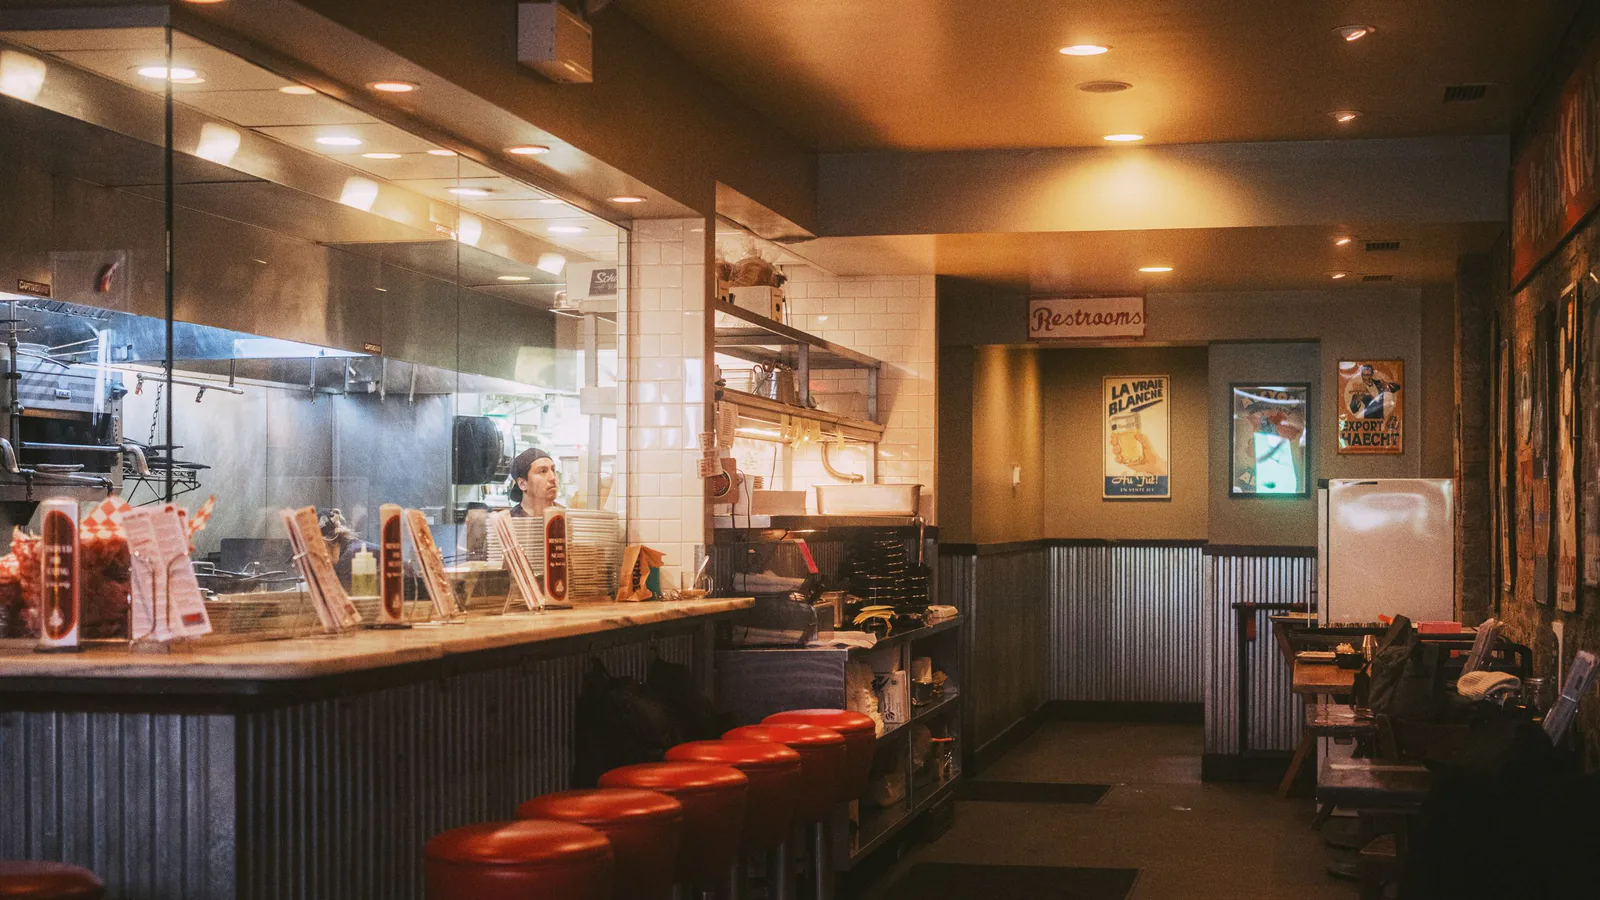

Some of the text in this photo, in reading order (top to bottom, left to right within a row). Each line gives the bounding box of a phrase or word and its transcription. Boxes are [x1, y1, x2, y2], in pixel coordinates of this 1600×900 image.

[1031, 307, 1142, 332] Restrooms
[1111, 379, 1163, 400] LA VRAIE
[1109, 389, 1163, 417] BLANCHE
[1341, 421, 1383, 431] EXPORT
[1340, 432, 1399, 446] HAECHT
